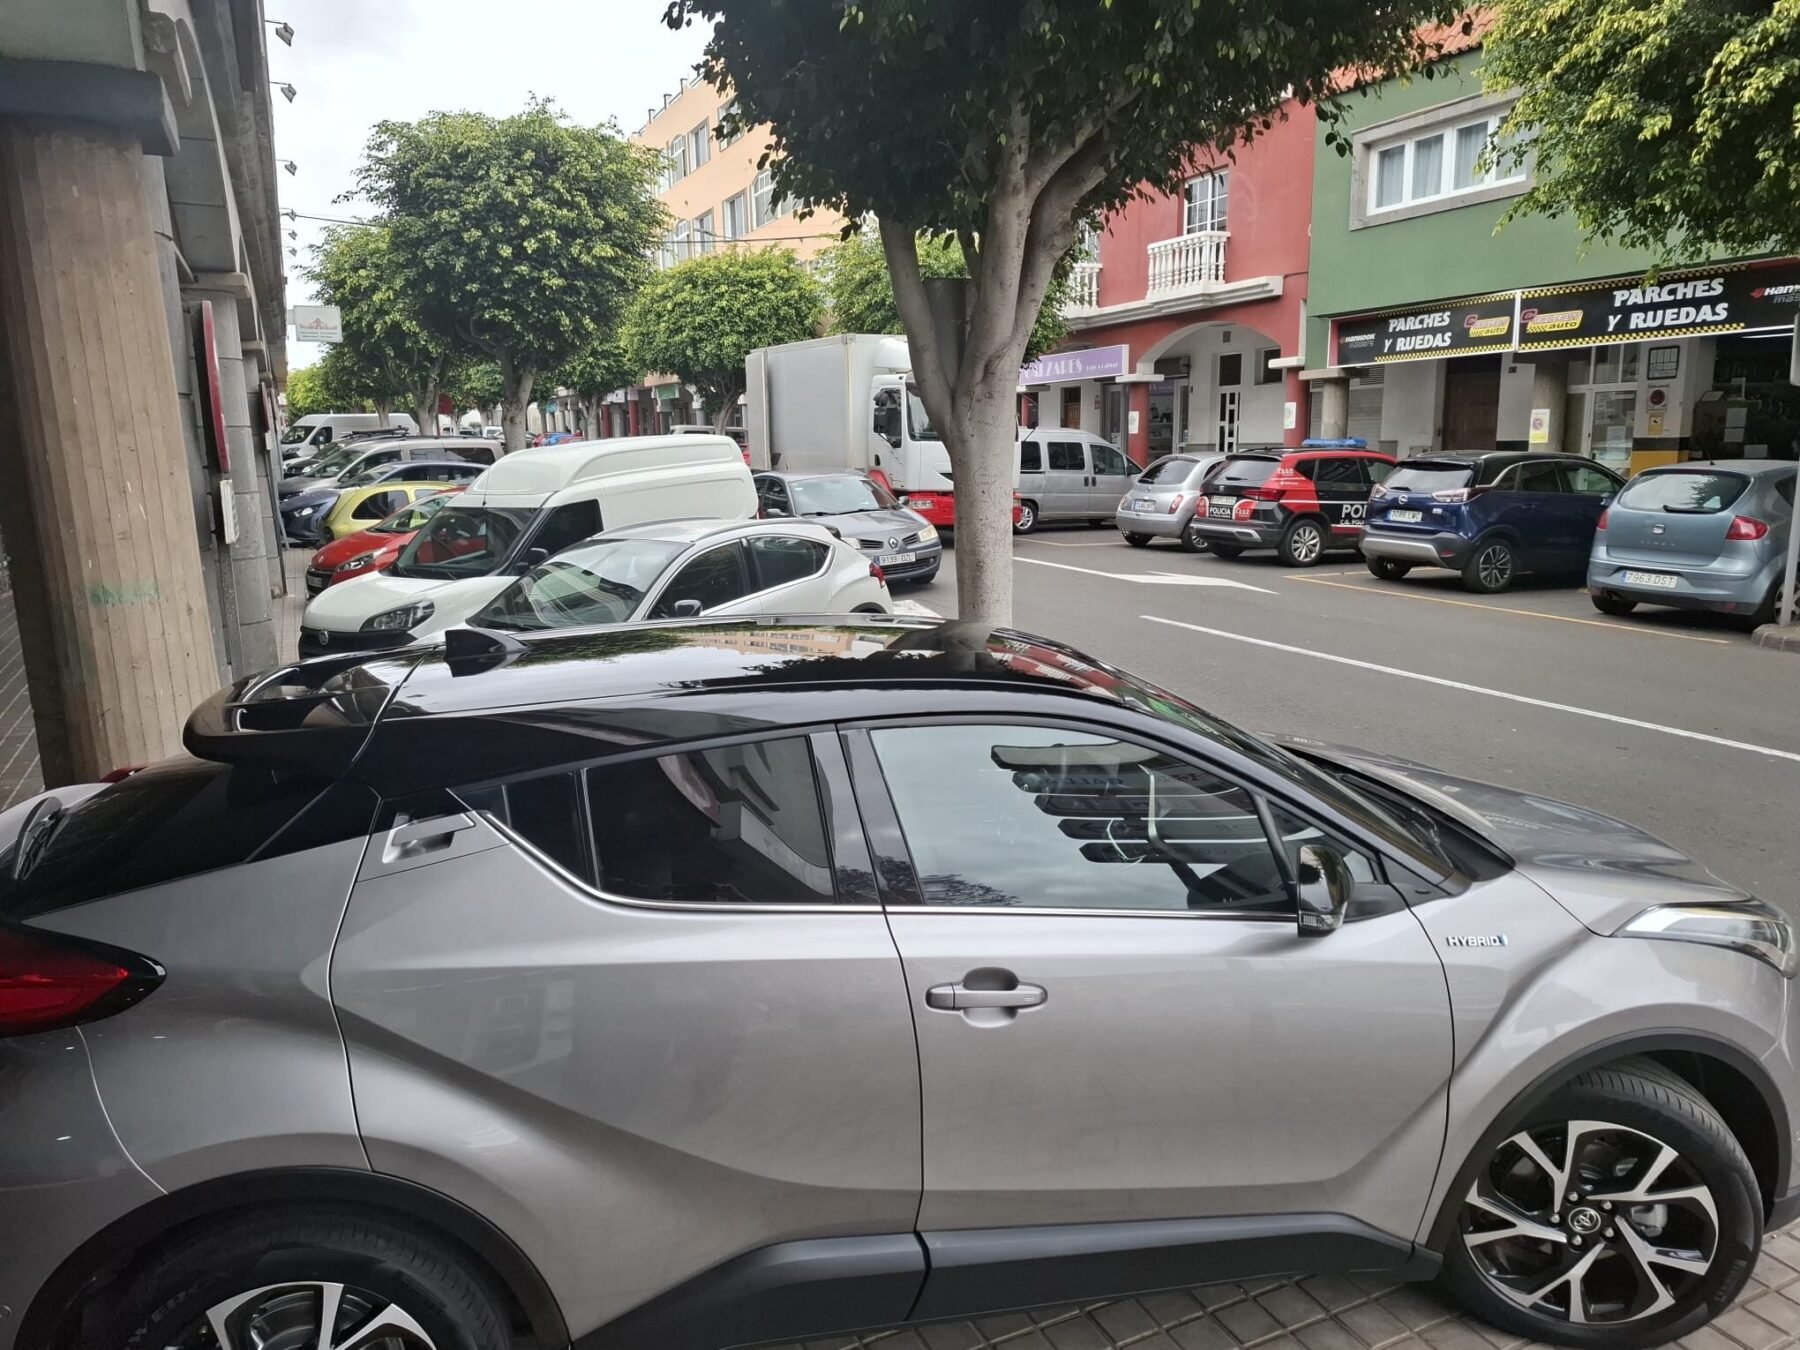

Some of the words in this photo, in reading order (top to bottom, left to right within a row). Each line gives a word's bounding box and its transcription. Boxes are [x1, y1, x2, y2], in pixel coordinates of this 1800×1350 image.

[1613, 278, 1725, 307] PARCHES
[1388, 311, 1452, 333] PARCHES
[1607, 314, 1621, 332] Y
[1629, 303, 1729, 330] RUEDAS
[1383, 338, 1393, 353] Y
[1395, 332, 1452, 352] RUEDAS
[1627, 572, 1651, 584] 7963
[1653, 575, 1676, 587] DST
[1446, 935, 1503, 947] HYBRID
